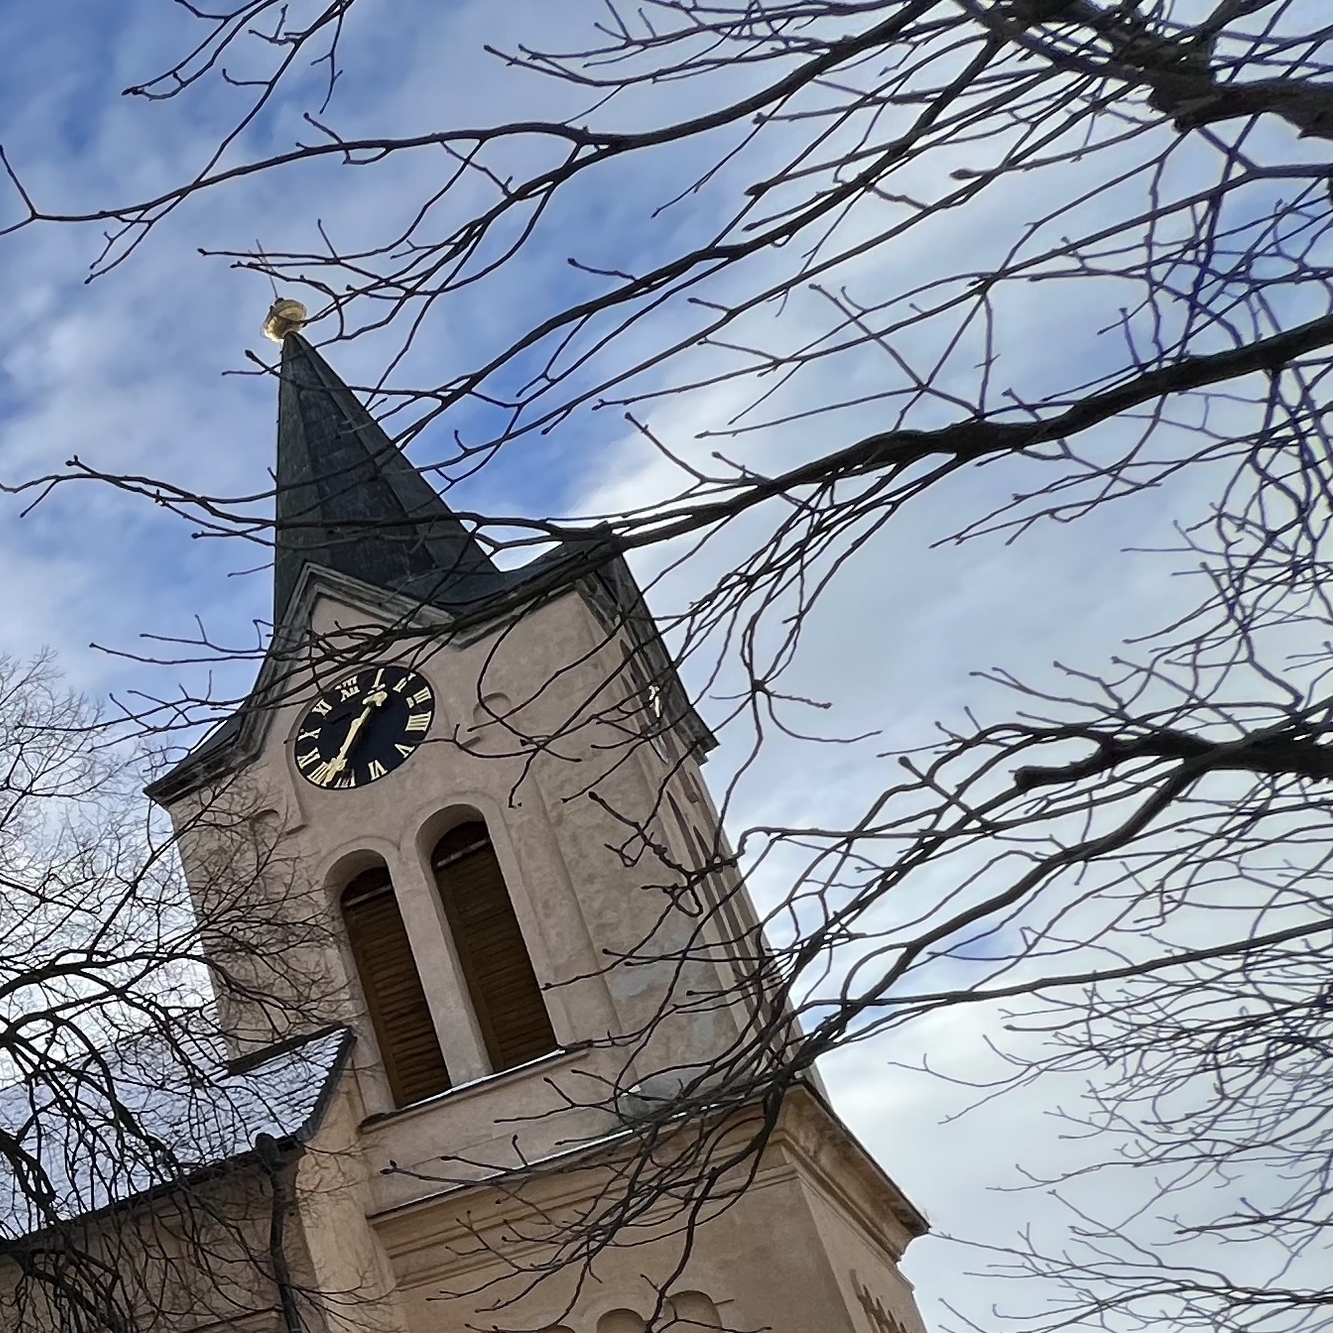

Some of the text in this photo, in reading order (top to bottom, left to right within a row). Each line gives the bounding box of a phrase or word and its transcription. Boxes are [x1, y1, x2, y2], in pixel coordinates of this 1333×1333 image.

[405, 710, 432, 732] IIII
[394, 743, 415, 759] V
[368, 759, 389, 781] VI
